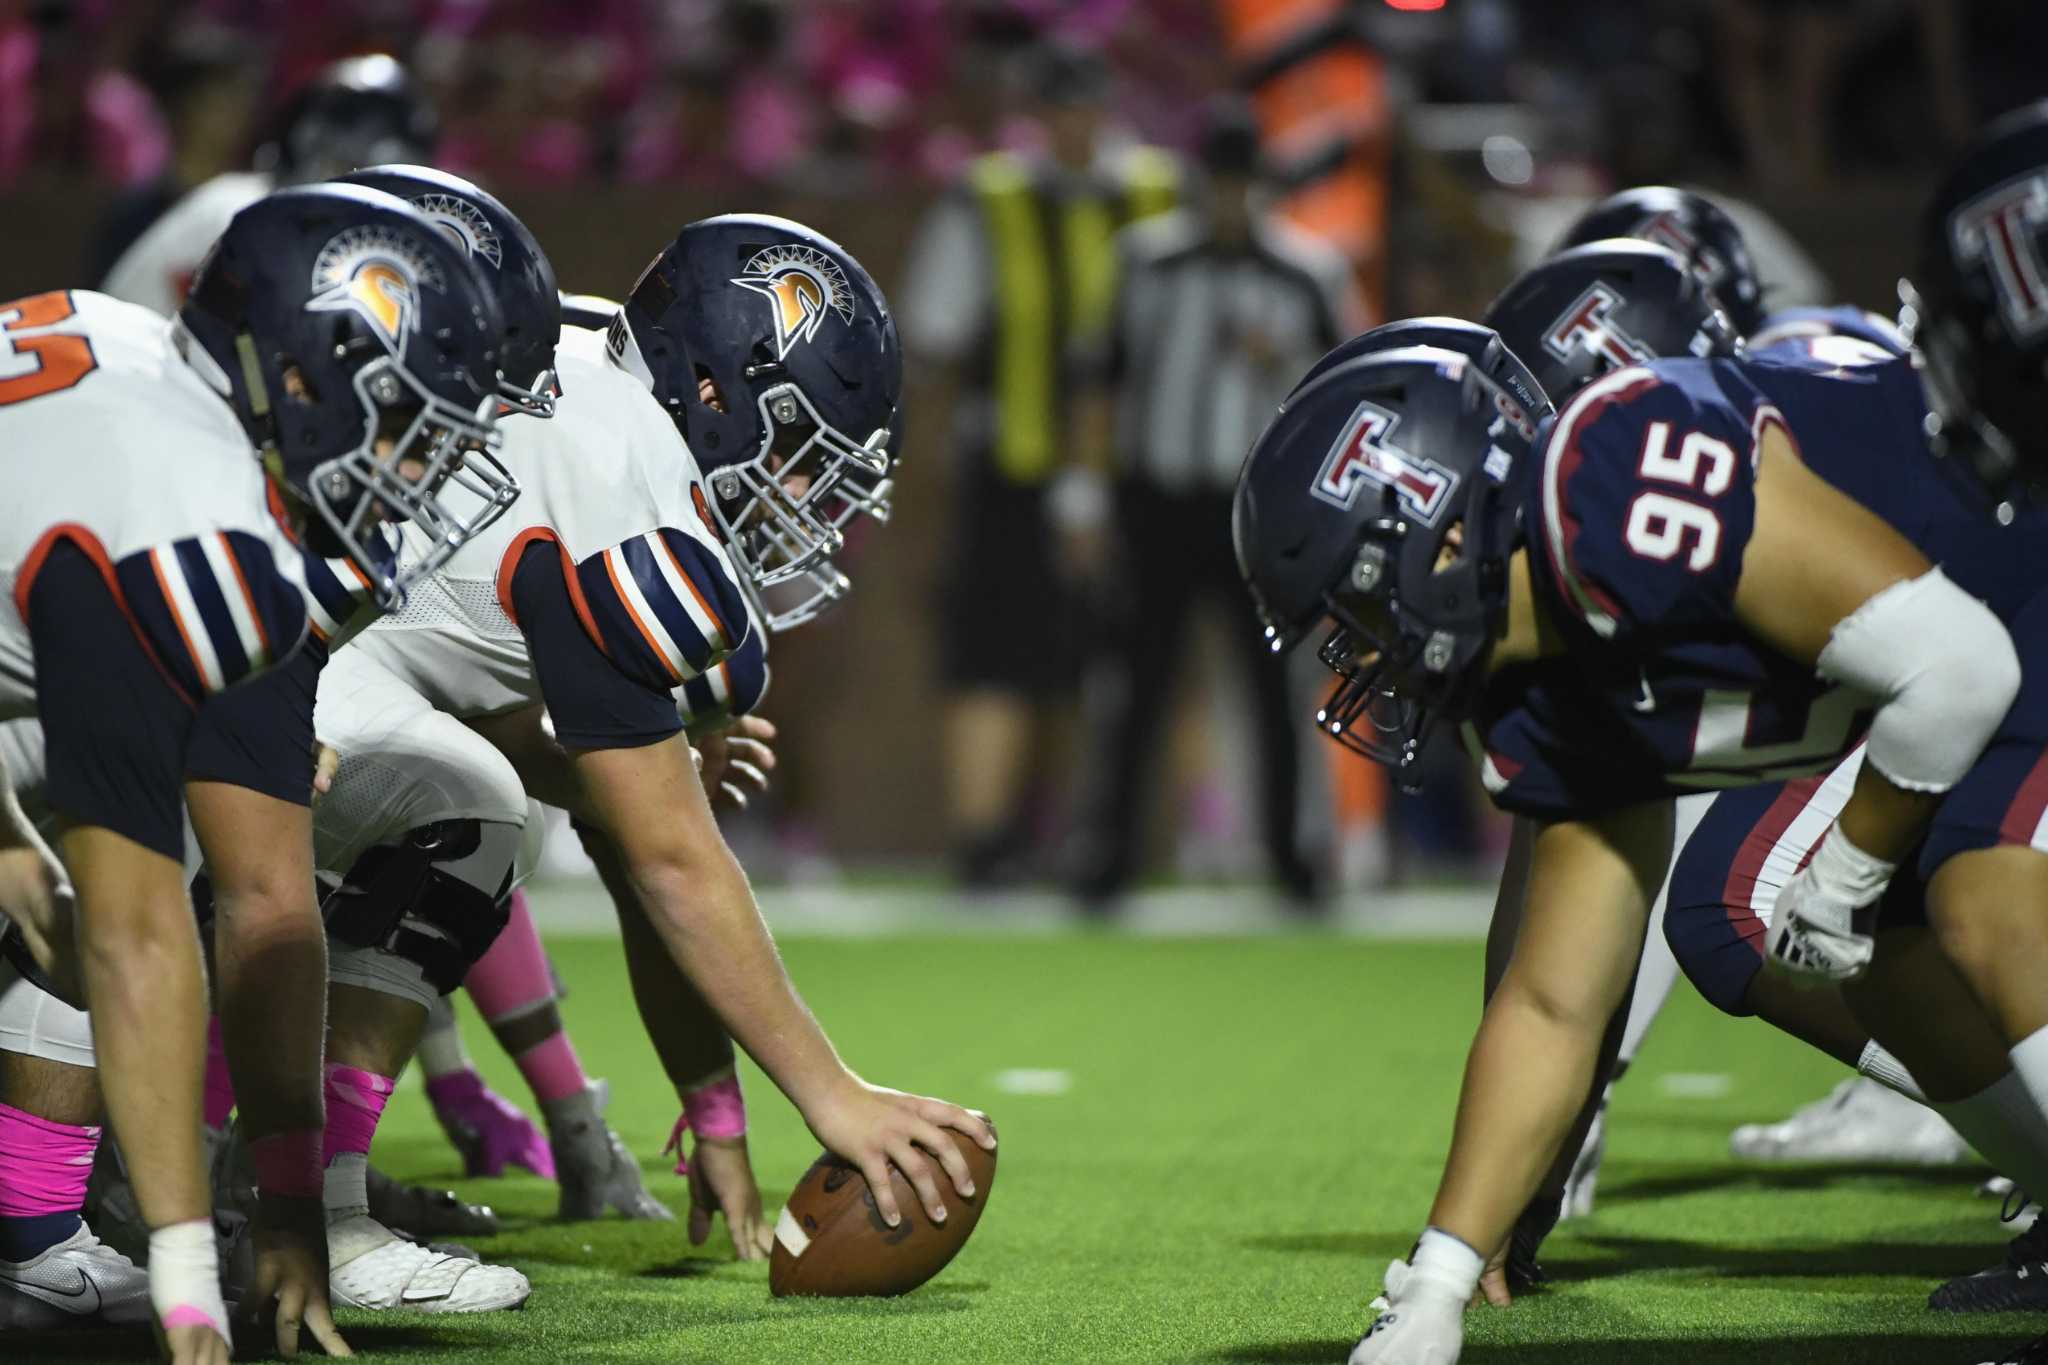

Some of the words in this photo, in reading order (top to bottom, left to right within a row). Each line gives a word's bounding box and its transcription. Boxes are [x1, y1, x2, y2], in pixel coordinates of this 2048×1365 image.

[1541, 279, 1660, 372] T
[1310, 399, 1461, 529] T
[1623, 419, 1738, 575] 95
